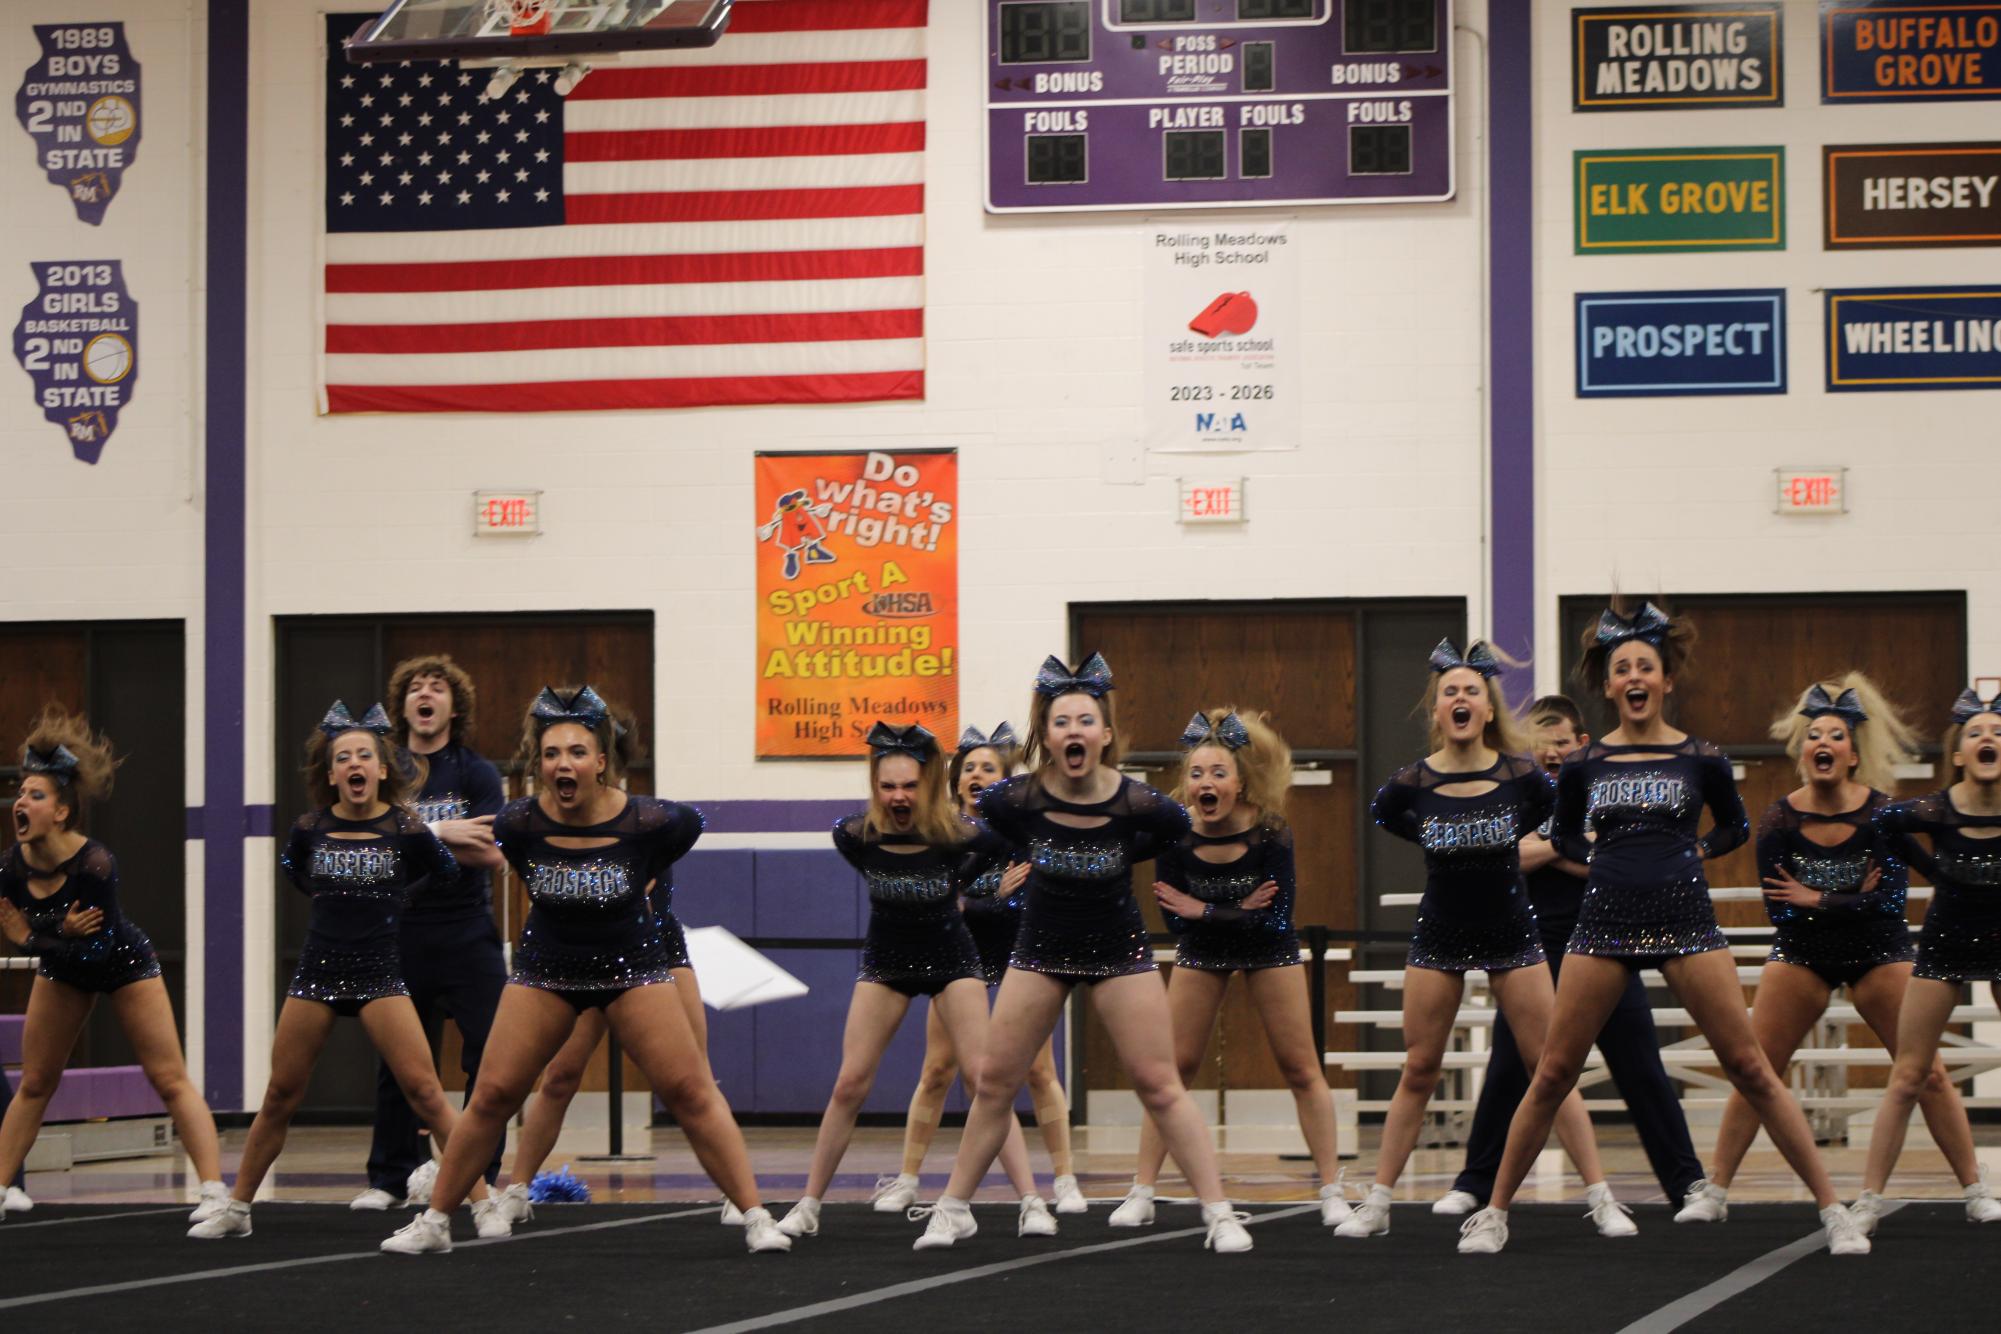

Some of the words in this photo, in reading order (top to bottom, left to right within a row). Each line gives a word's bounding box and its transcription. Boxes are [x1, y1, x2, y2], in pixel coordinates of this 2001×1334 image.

[50, 27, 115, 50] 1989
[1175, 35, 1216, 52] POSS
[1607, 22, 1748, 58] ROLLING
[1854, 15, 2000, 52] BUFFALO
[48, 54, 120, 76] BOYS
[1159, 54, 1234, 76] PERIOD
[1331, 63, 1401, 85] BONUS
[1596, 58, 1763, 95] MEADOWS
[1873, 53, 1984, 87] GROVE
[26, 80, 135, 97] GYMNASTICS
[1035, 71, 1103, 94] BONUS
[1024, 111, 1088, 133] FOULS
[1149, 107, 1225, 129] PLAYER
[1240, 104, 1305, 126] FOULS
[1347, 101, 1413, 123] FOULS
[57, 124, 82, 143] IN
[46, 148, 124, 170] STATE
[1590, 183, 1650, 216] ELK
[1659, 180, 1770, 214] GROVE
[1862, 175, 2000, 211] HERSEY
[1155, 234, 1210, 250] Rolling
[1214, 233, 1288, 246] Meadows
[1174, 251, 1210, 268] High
[1215, 250, 1269, 264] School
[47, 265, 112, 287] 2013
[43, 292, 120, 314] GIRLS
[24, 318, 130, 333] BASKETBALL
[1169, 340, 1194, 353] safe
[1197, 341, 1234, 354] sports
[1236, 338, 1274, 352] school
[1592, 322, 1770, 358] PROSPECT
[53, 362, 79, 381] IN
[43, 386, 121, 408] STATE
[1170, 385, 1214, 401] 2023
[1231, 384, 1274, 400] 2026
[863, 451, 920, 488] Do
[815, 478, 952, 524] what's
[1191, 487, 1232, 516] EXIT
[1791, 477, 1831, 506] EXIT
[488, 498, 528, 528] EXIT
[826, 509, 942, 552] right!
[768, 571, 871, 616] Sport
[880, 560, 909, 589] A
[785, 621, 931, 650] Winning
[763, 647, 953, 679] Attitude!
[768, 697, 842, 719] Rolling
[848, 696, 948, 715] Meadows
[795, 720, 843, 742] High
